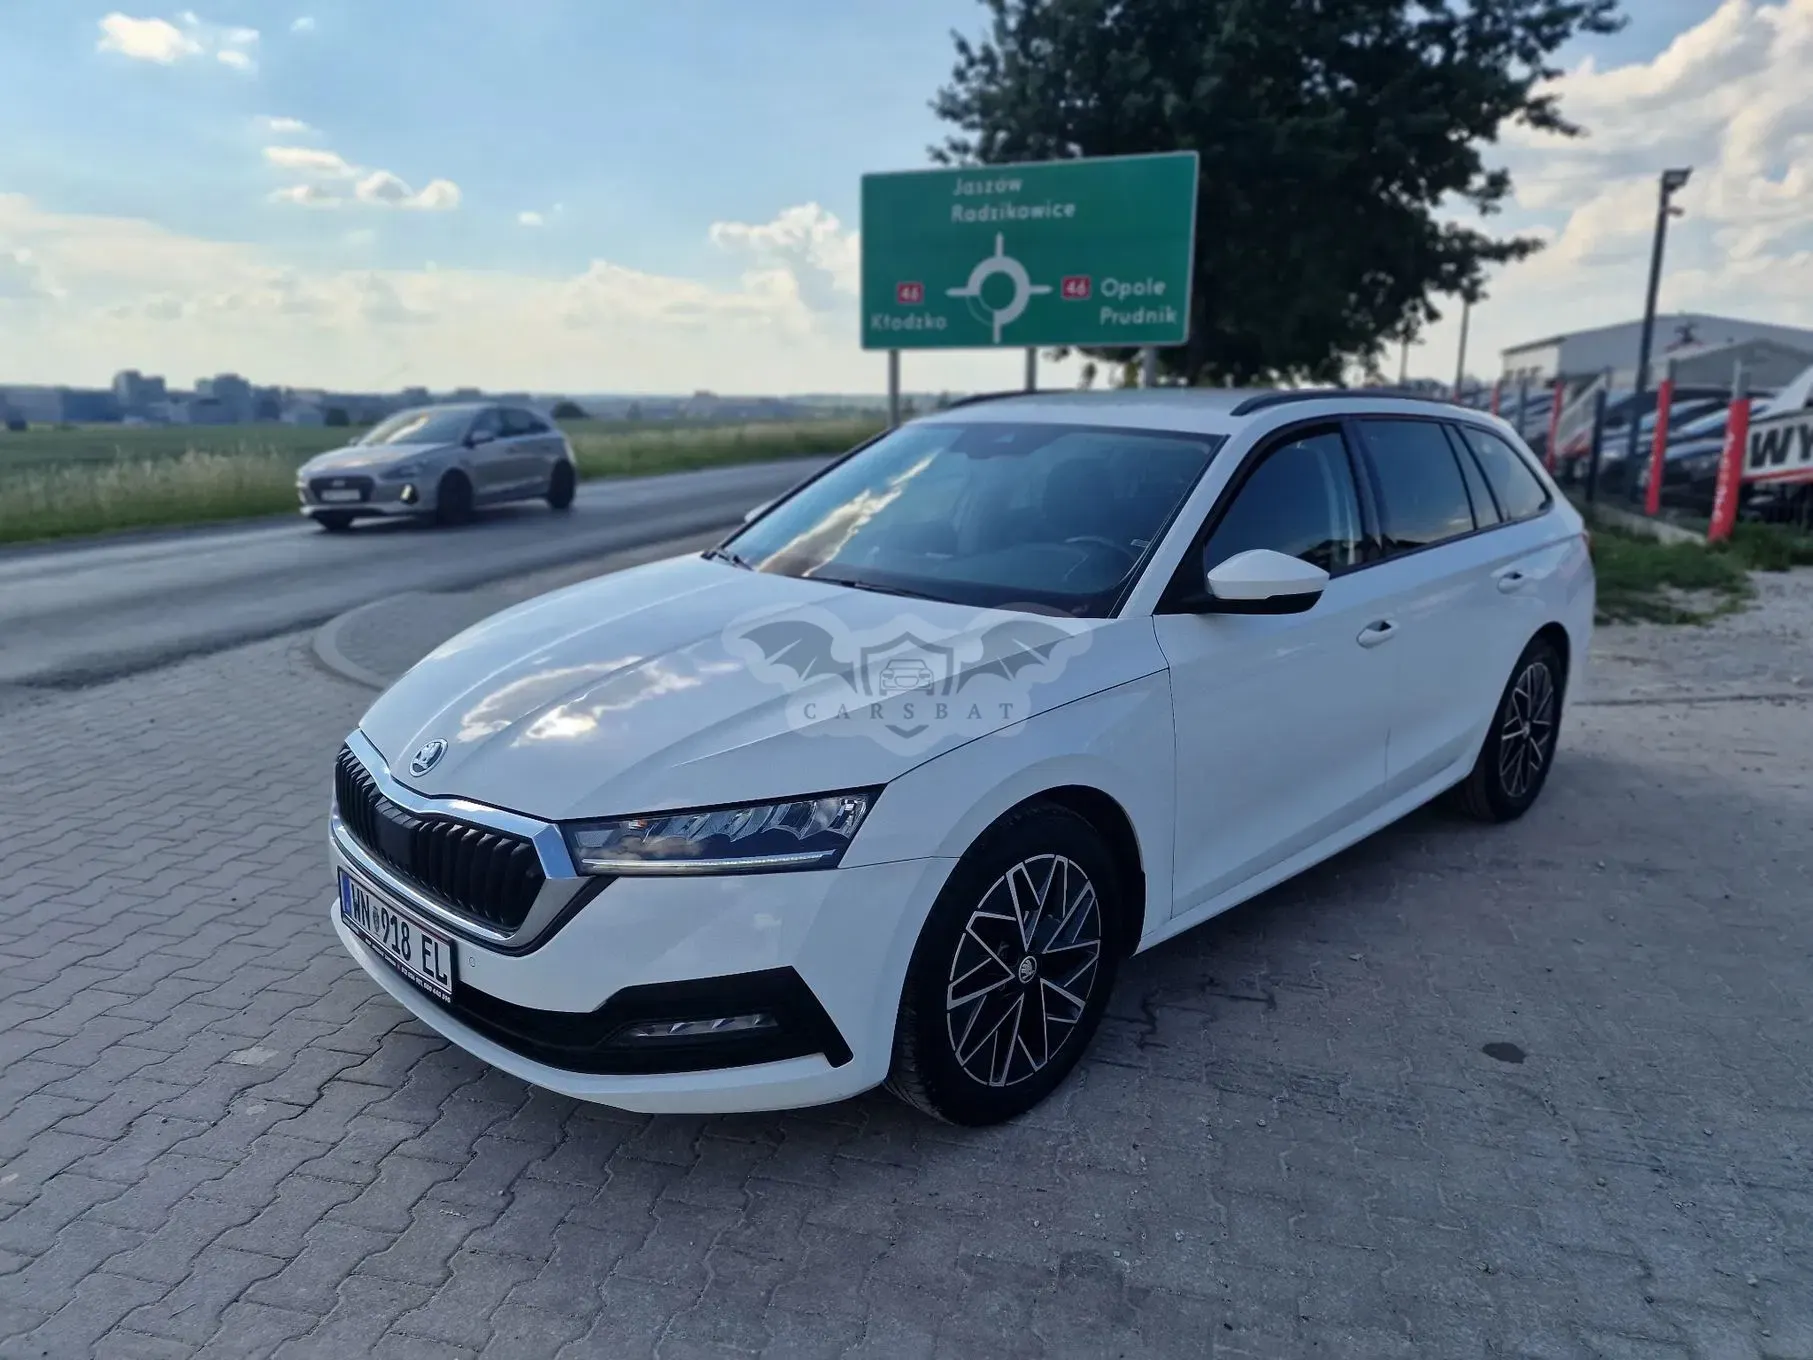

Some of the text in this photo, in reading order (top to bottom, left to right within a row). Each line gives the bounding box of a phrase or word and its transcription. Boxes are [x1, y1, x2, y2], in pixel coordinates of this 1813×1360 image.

[953, 176, 1023, 196] Jaszów
[951, 200, 1076, 223] Radzikowice
[1066, 279, 1087, 297] 46
[1100, 277, 1167, 302] Opole
[871, 312, 947, 331] Kłodzko
[1100, 305, 1177, 326] Prudnik
[351, 883, 371, 931] WN
[381, 908, 411, 962] 918
[422, 934, 447, 986] EL
